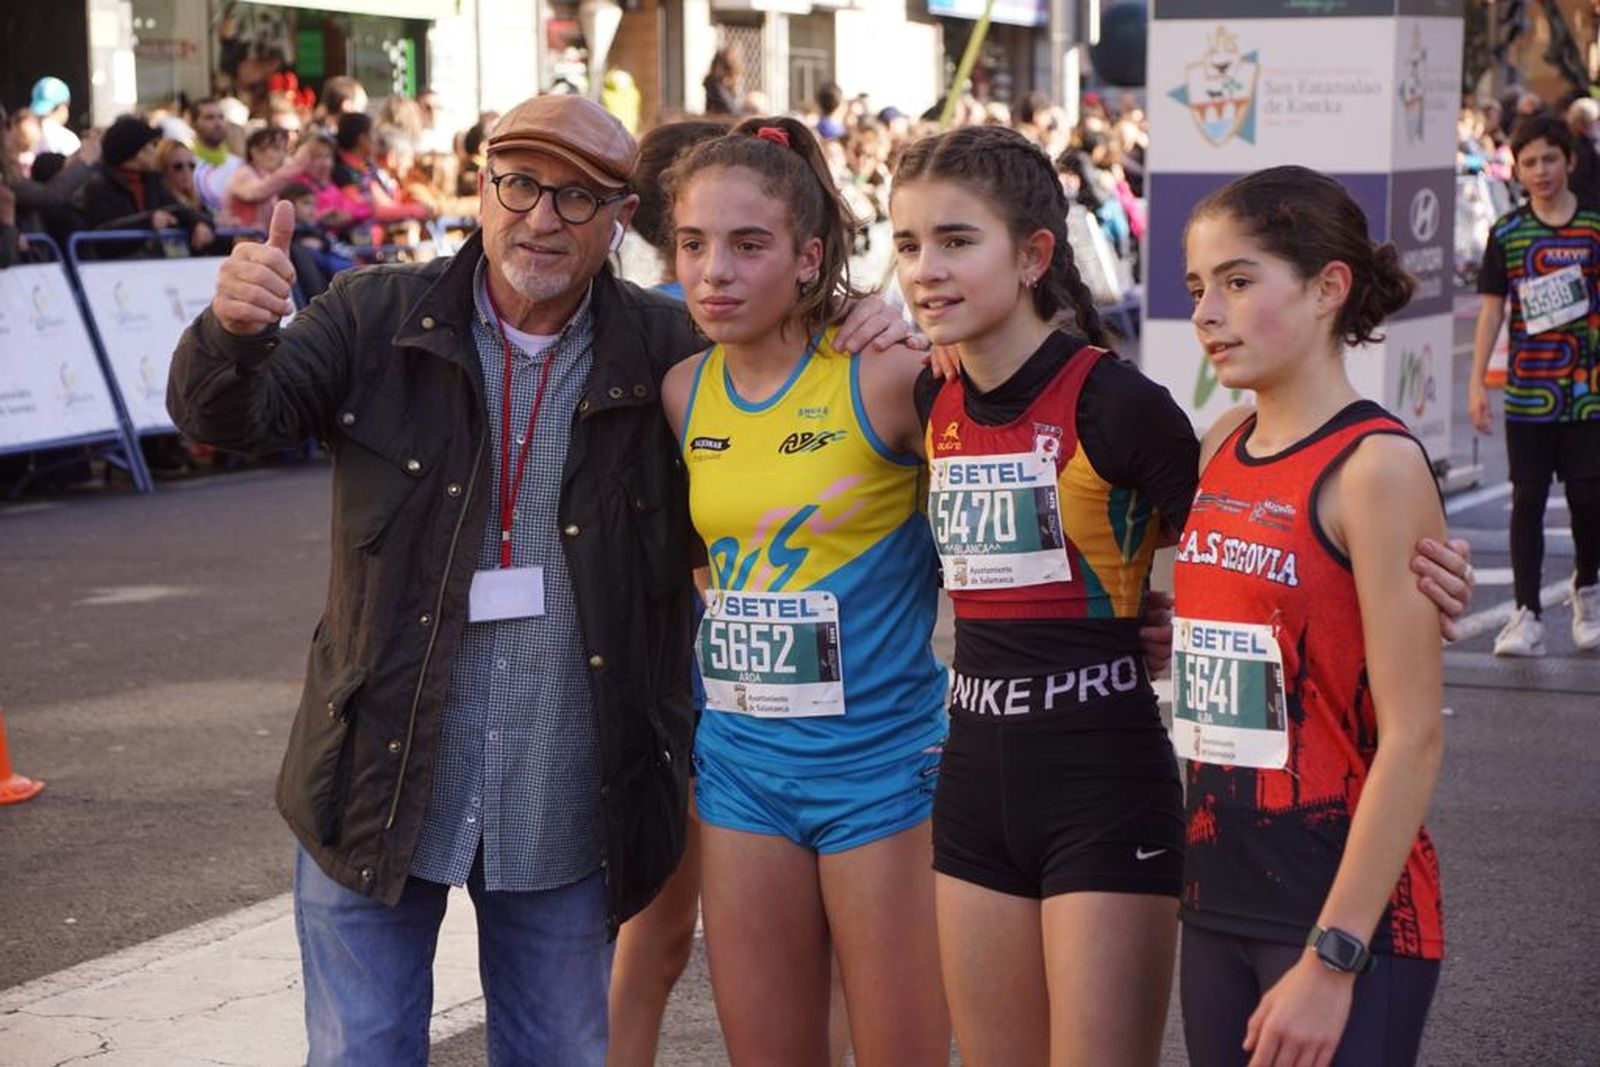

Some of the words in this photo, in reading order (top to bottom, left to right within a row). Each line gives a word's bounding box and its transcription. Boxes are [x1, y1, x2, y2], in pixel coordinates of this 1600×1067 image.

[949, 461, 1037, 485] SETEL
[936, 490, 1017, 544] 5470
[1221, 537, 1300, 587] SEGOVIA
[725, 596, 819, 618] SETEL
[710, 620, 796, 674] 5652
[1191, 626, 1268, 655] SETEL
[952, 672, 1034, 716] NIKE
[1044, 655, 1138, 710] PRO
[1185, 653, 1239, 715] 5641
